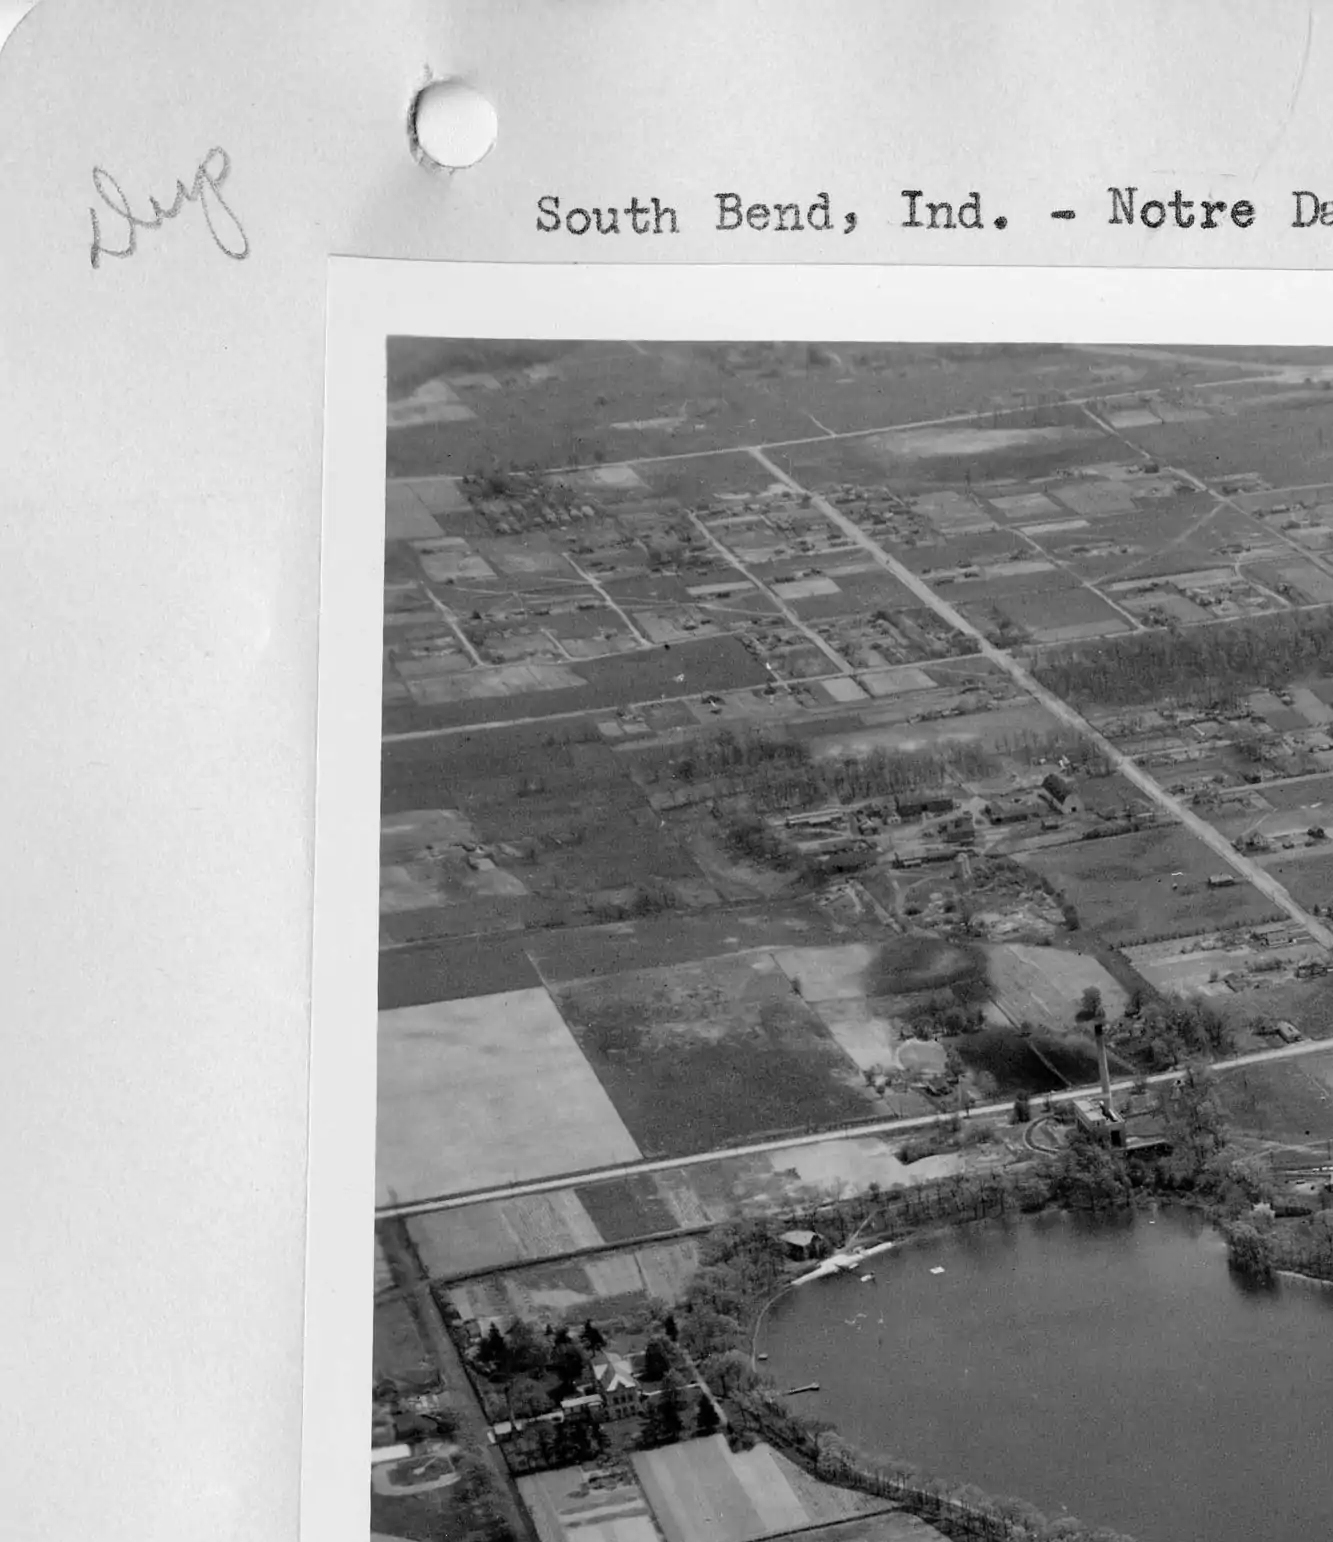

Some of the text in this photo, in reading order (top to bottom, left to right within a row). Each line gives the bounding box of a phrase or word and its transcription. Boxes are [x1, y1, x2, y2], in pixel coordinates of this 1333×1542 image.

[536, 195, 680, 236] South
[713, 191, 858, 235] Bend,
[900, 189, 1009, 231] Ind.
[1050, 209, 1077, 221] -
[1106, 186, 1256, 230] Notre
